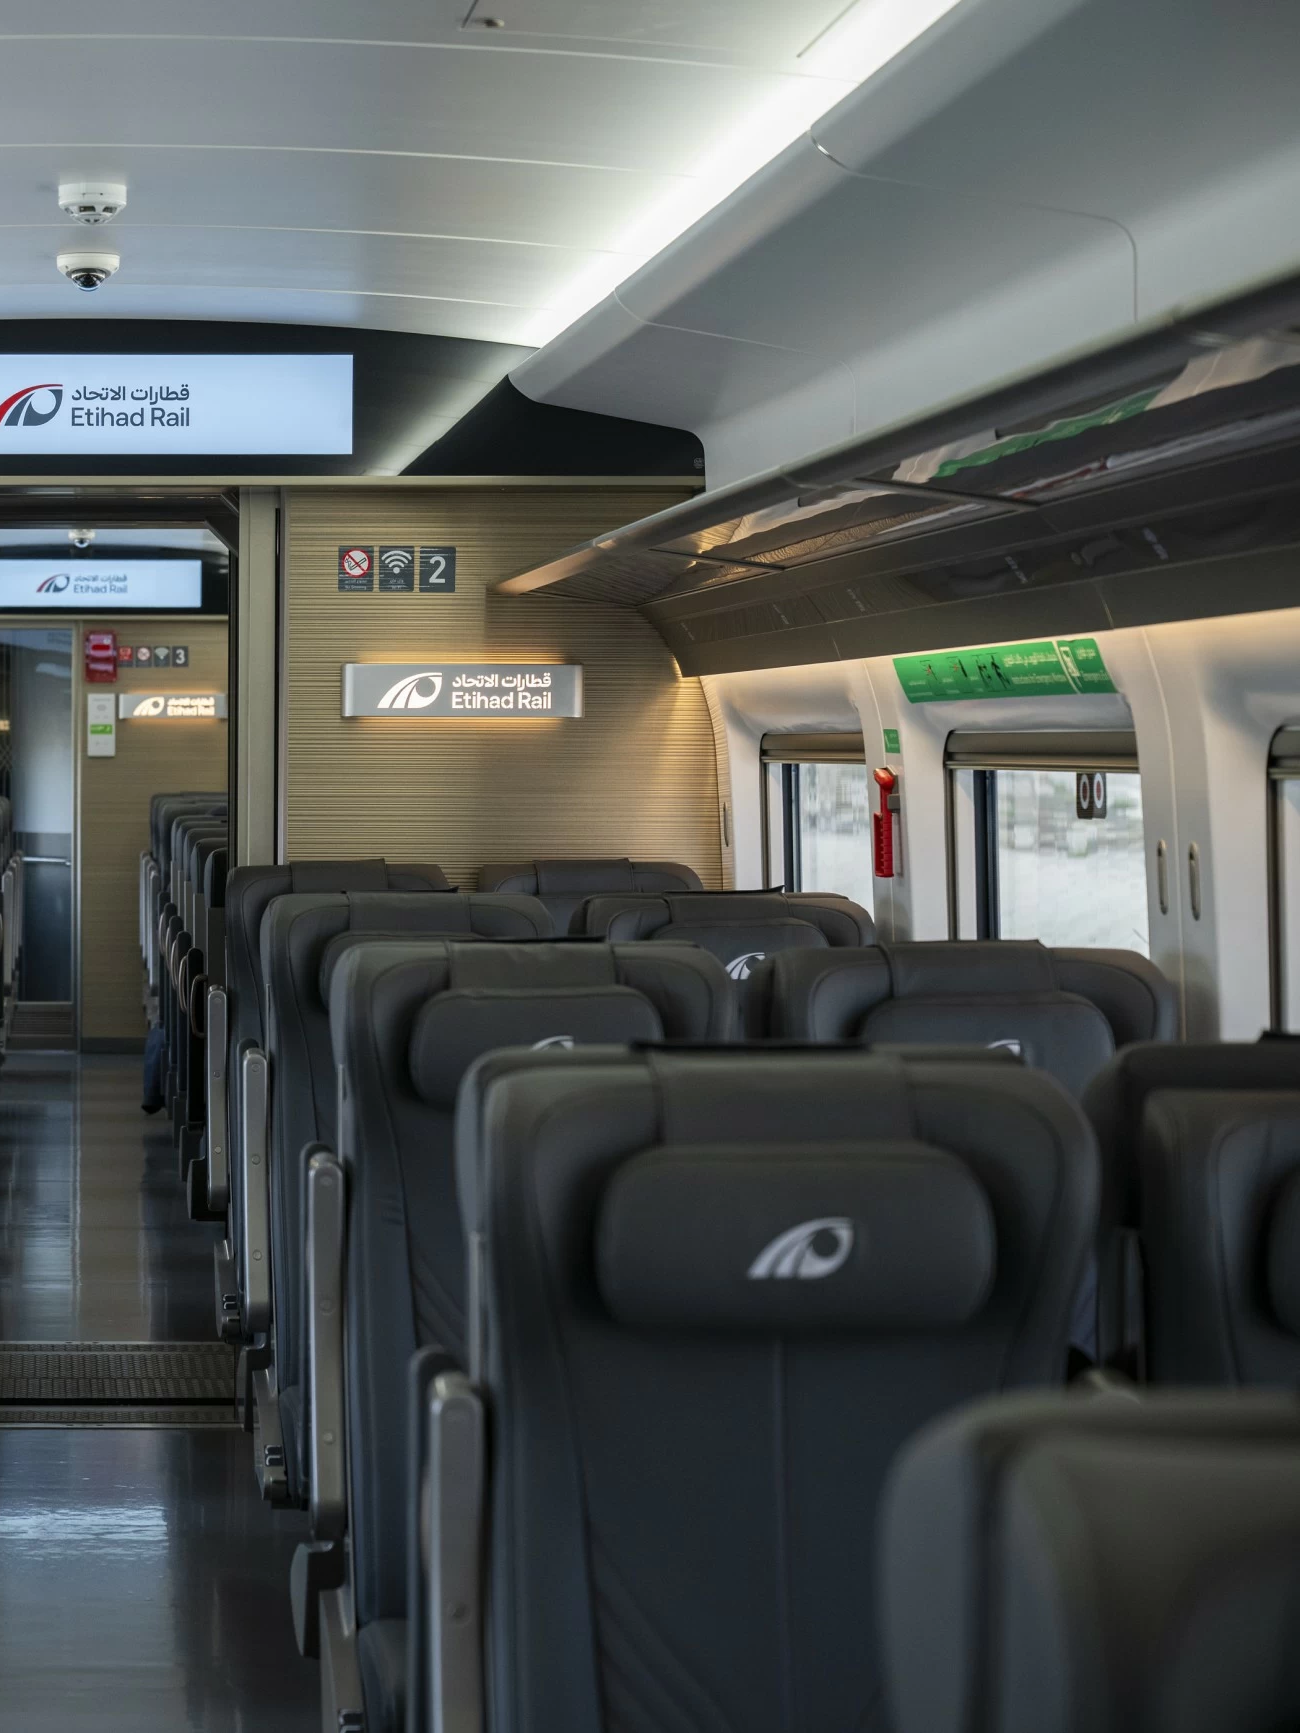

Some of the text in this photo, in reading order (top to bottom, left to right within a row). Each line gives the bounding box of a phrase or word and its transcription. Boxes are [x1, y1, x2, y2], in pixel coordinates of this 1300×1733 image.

[71, 383, 190, 405] قطارات الاتحاد
[71, 406, 190, 427] Etihad Rail
[429, 555, 446, 584] 2
[73, 583, 128, 594] Etihad Rail
[175, 649, 186, 665] 3
[451, 672, 552, 691] قطارات الاتحاد
[451, 691, 552, 709] Etihad Rail
[167, 705, 198, 716] Etihad
